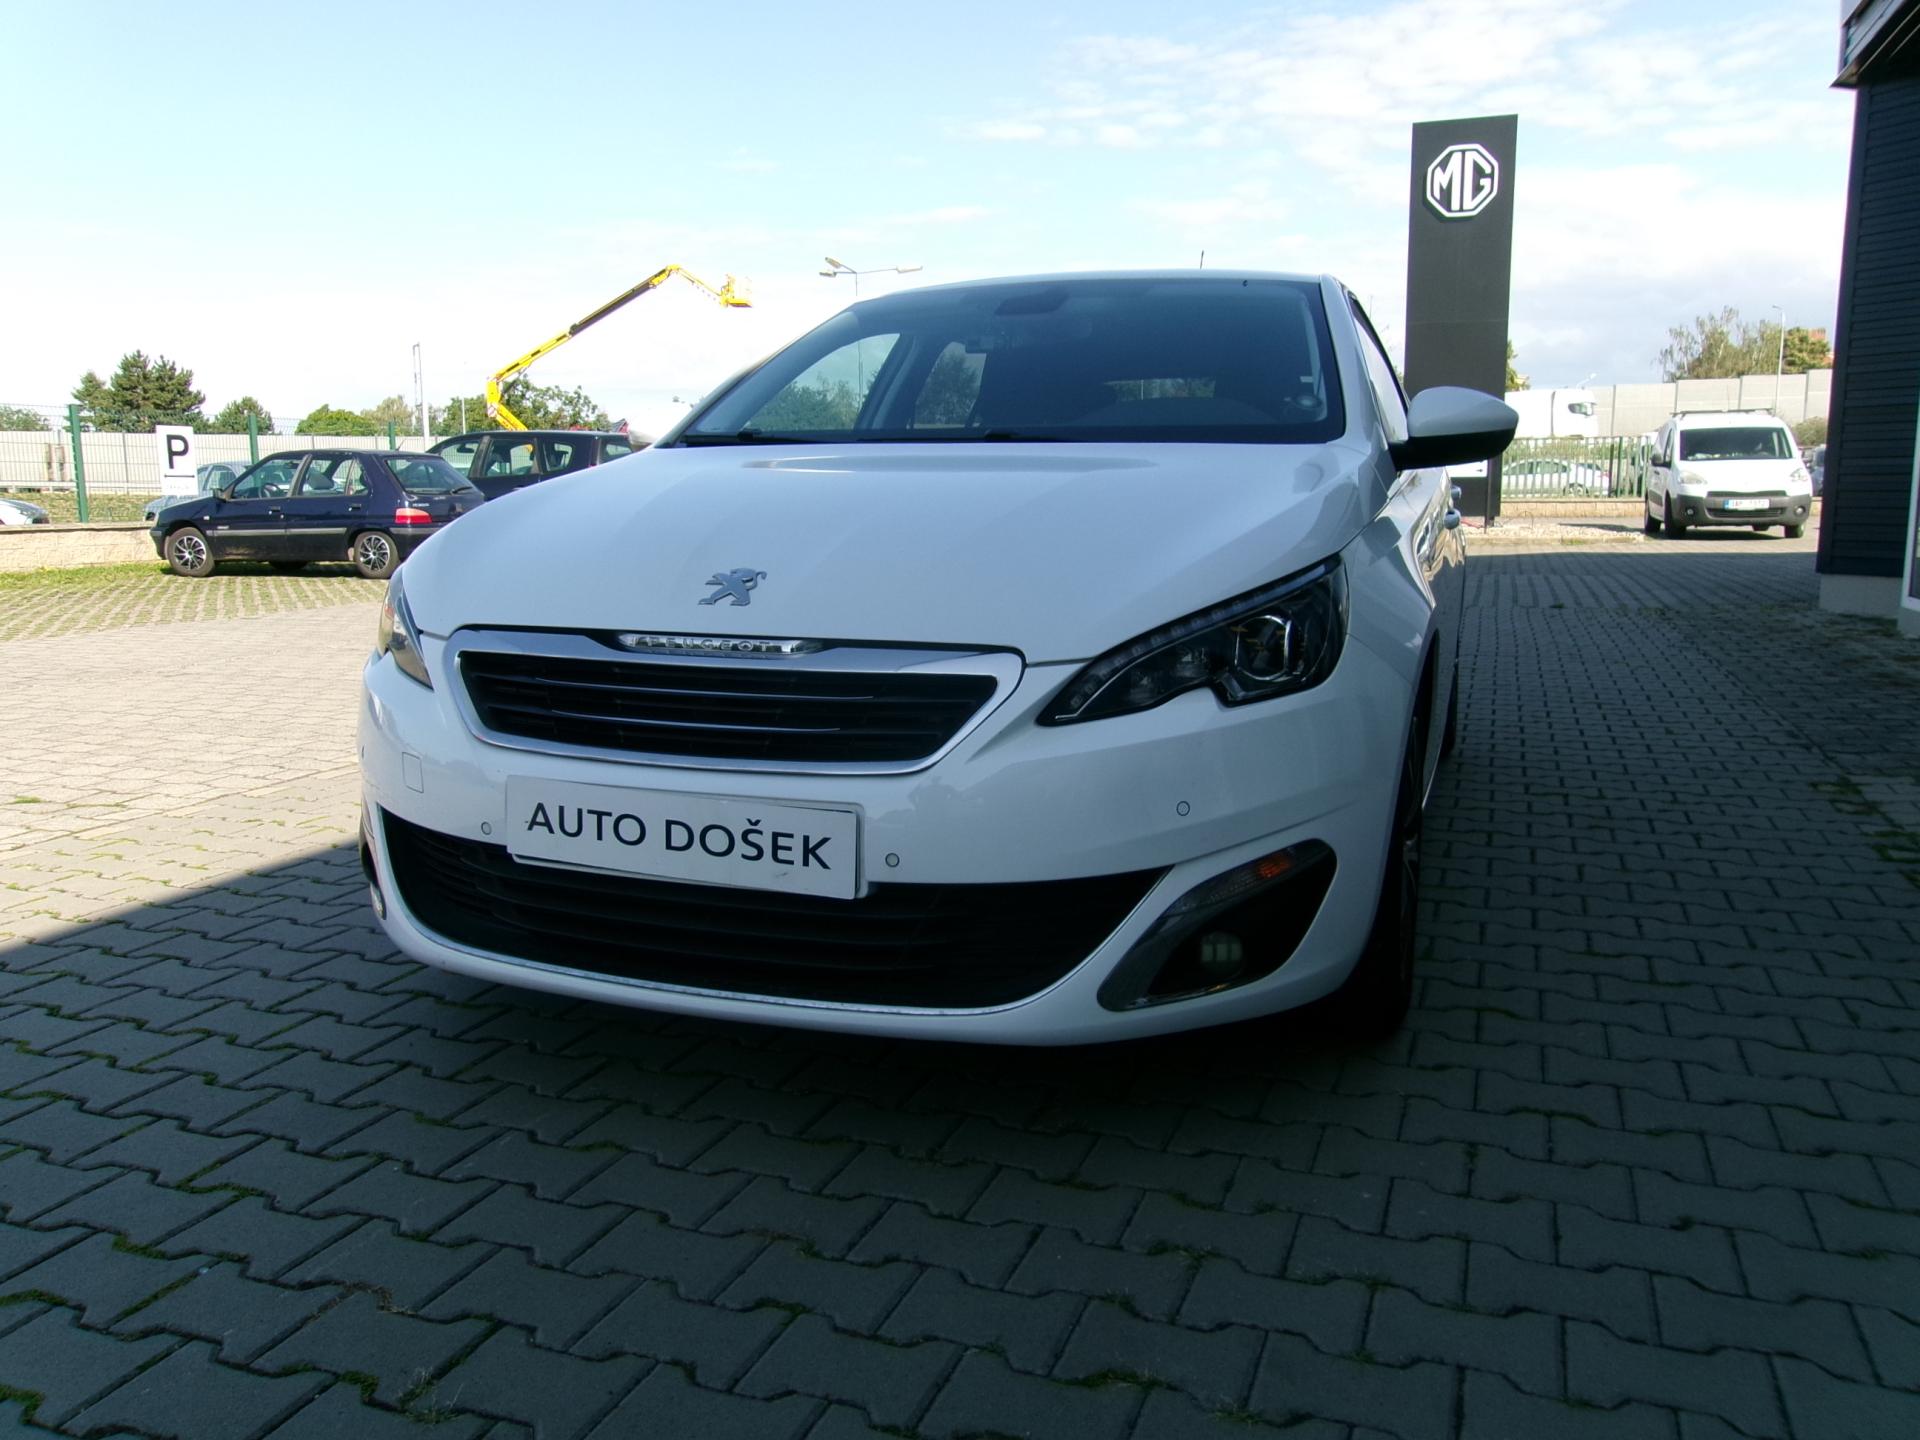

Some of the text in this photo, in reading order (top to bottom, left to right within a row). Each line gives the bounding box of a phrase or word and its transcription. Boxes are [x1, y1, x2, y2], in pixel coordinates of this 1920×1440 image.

[1433, 150, 1492, 211] MG
[166, 434, 189, 469] P
[647, 636, 771, 652] PEUGEOT
[527, 802, 832, 870] AUTO DOŠEK
